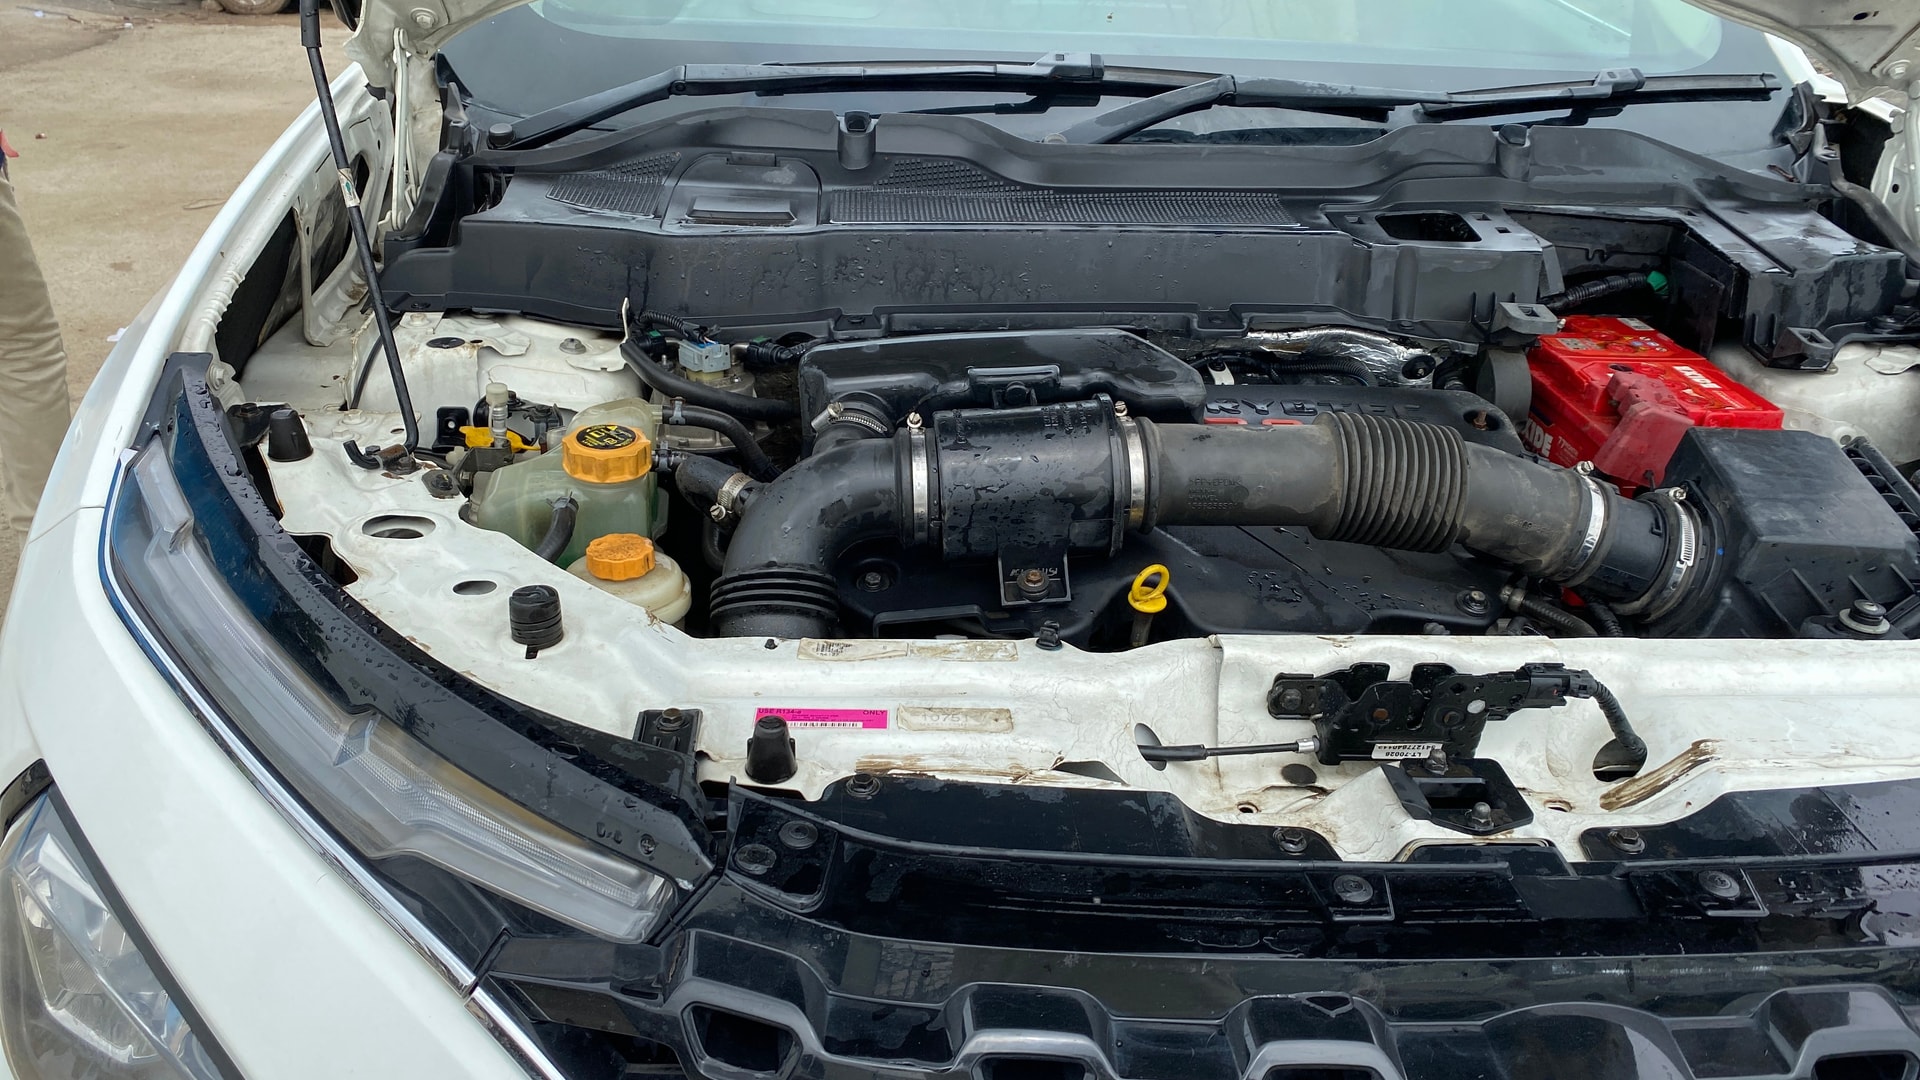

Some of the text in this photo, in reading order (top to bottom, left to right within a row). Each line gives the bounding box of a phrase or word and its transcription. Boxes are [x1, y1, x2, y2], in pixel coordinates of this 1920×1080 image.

[1672, 365, 1722, 389] EXIDE
[1204, 398, 1421, 417] RYOTEC
[1521, 418, 1554, 458] XIDE
